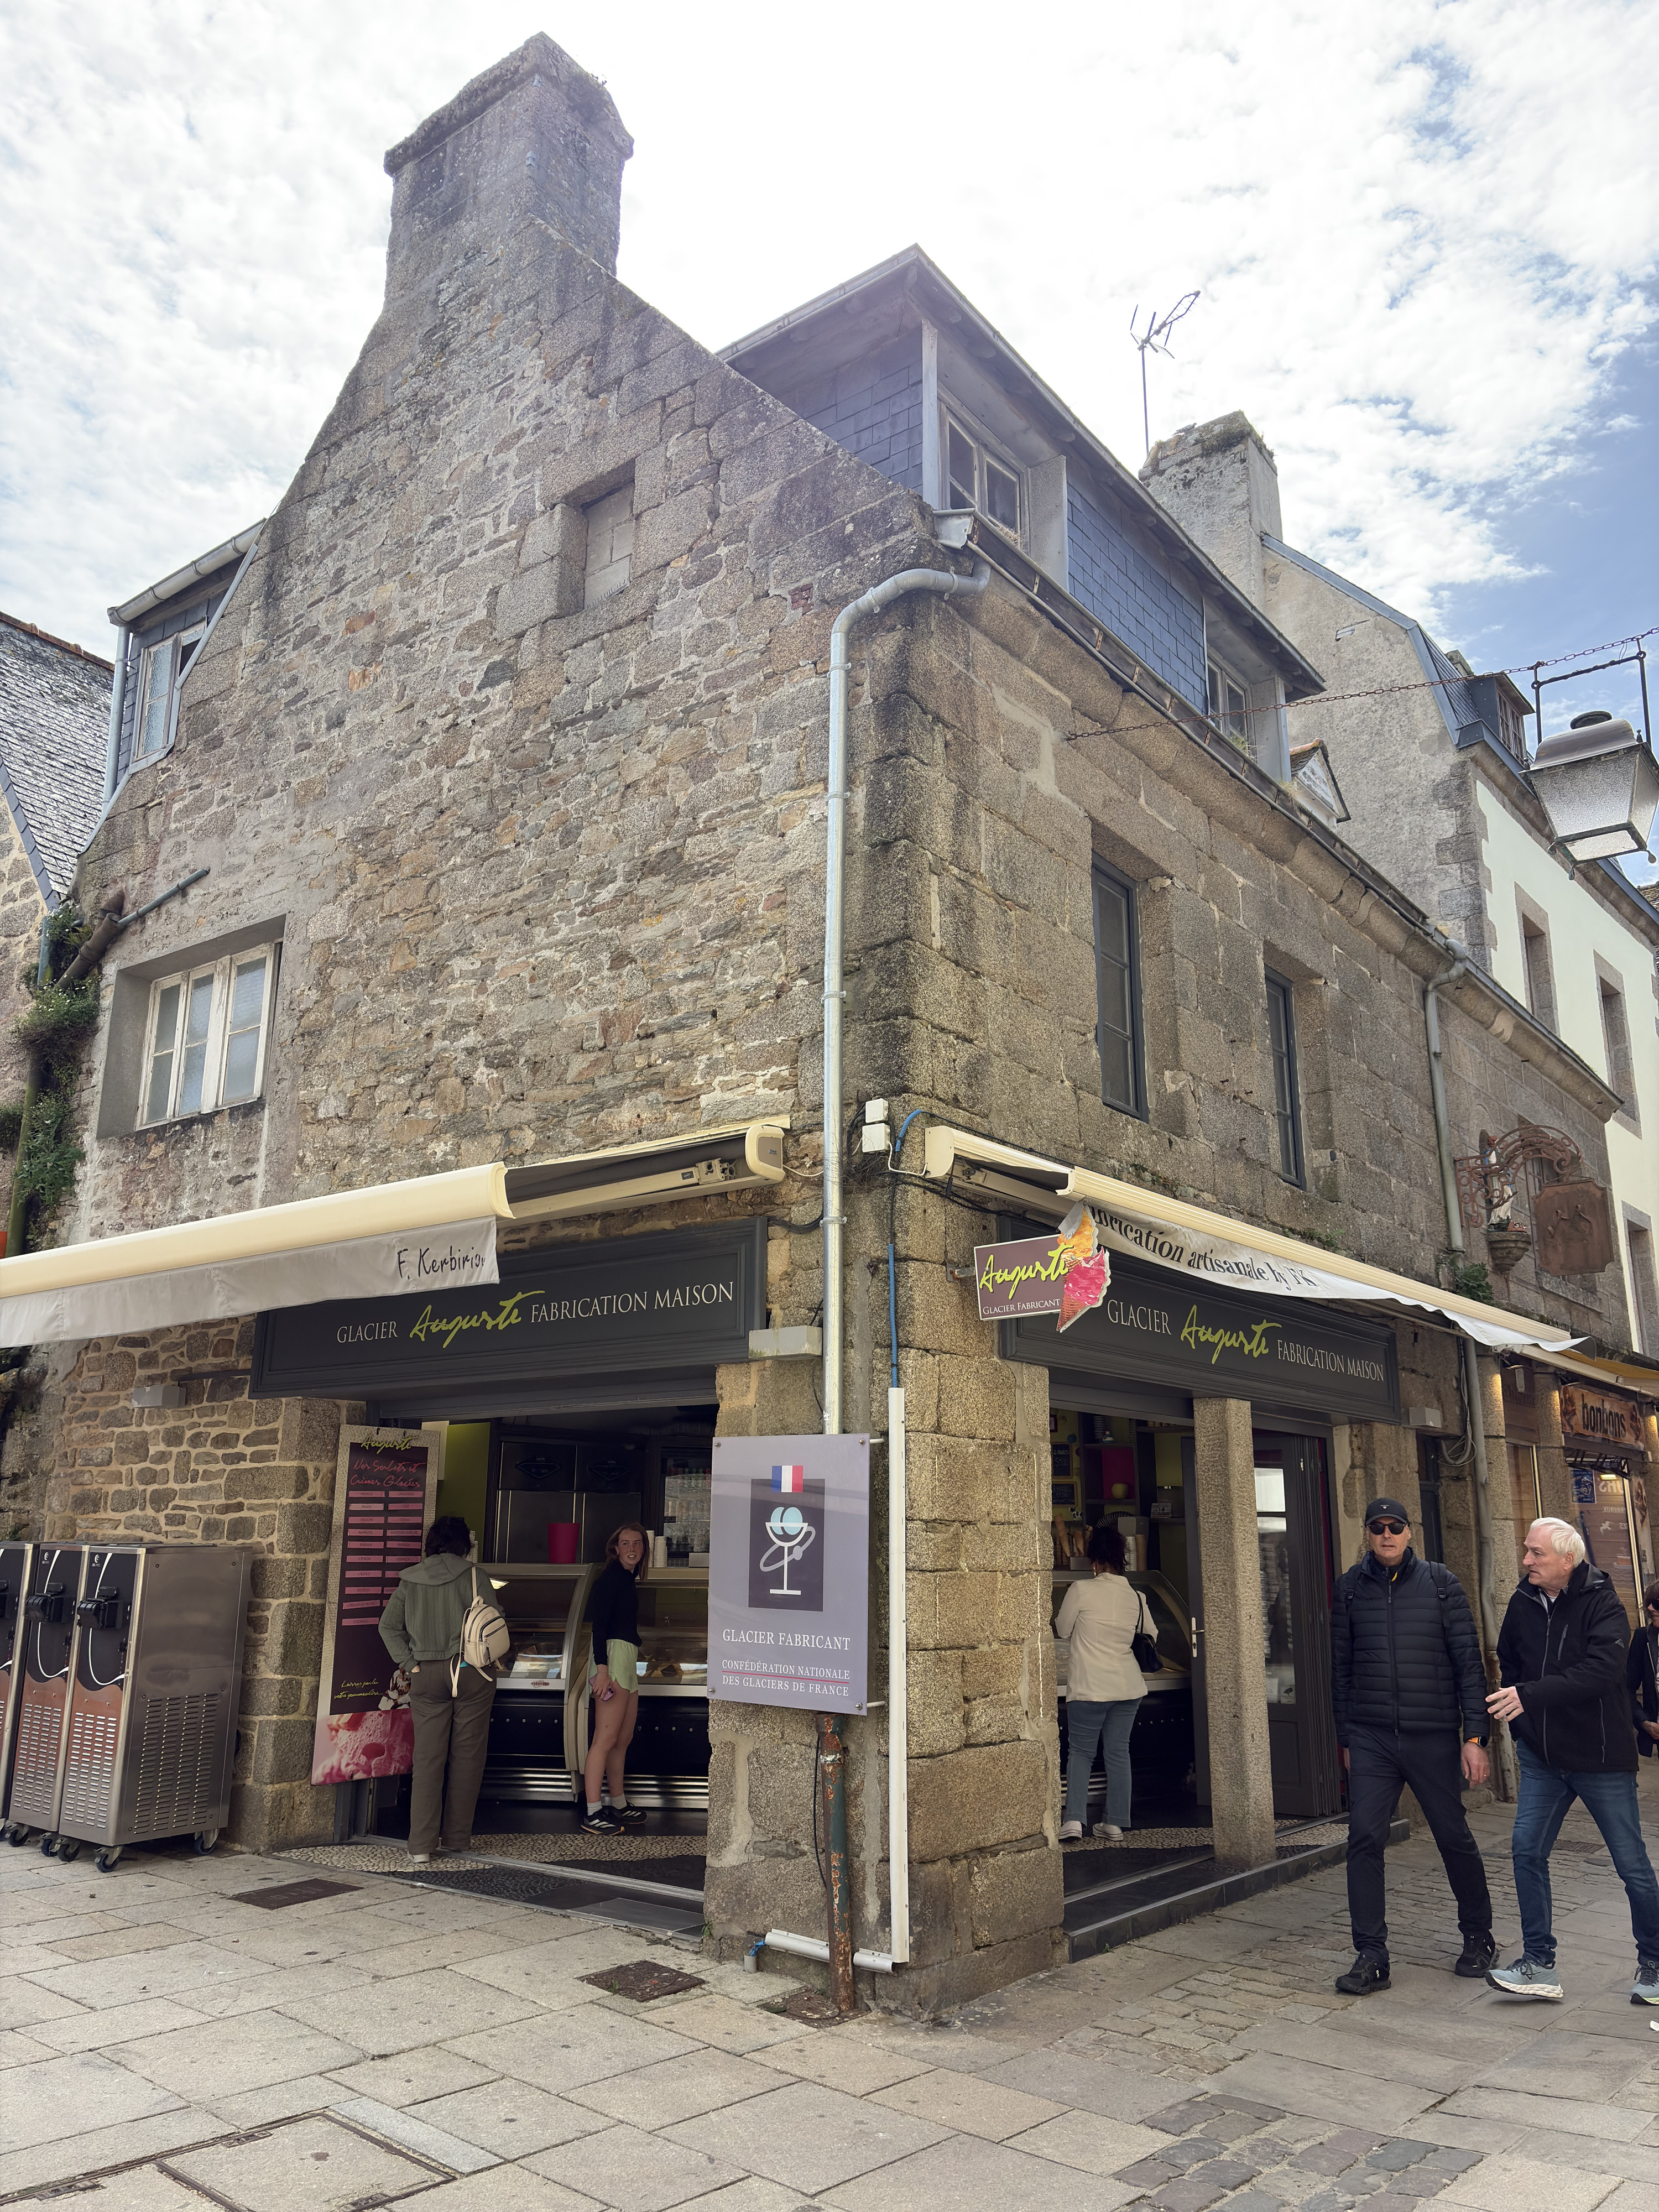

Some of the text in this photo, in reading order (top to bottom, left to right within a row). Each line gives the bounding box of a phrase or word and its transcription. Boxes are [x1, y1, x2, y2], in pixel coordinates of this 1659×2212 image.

[1088, 1205, 1318, 1291] abrication artisanale by FK
[397, 1248, 410, 1280] F.
[979, 1242, 1074, 1300] Auguste
[337, 1281, 734, 1348] GLACIER Auguste FABRICATION MAISON
[983, 1298, 1060, 1314] GLACIER FABRICANT
[1108, 1300, 1384, 1382] GLACIER Auguste FABRICATION MAISON
[1581, 1393, 1626, 1438] bonbons
[361, 1435, 418, 1454] Auguste
[353, 1458, 371, 1470] Nos
[373, 1460, 411, 1472] Sorbets
[723, 1629, 851, 1650] GLACIER FABRICANT
[722, 1659, 850, 1679] CONFÉDÉRATION NATIONALE
[722, 1675, 849, 1696] DES GLACIERS DE FRANCE
